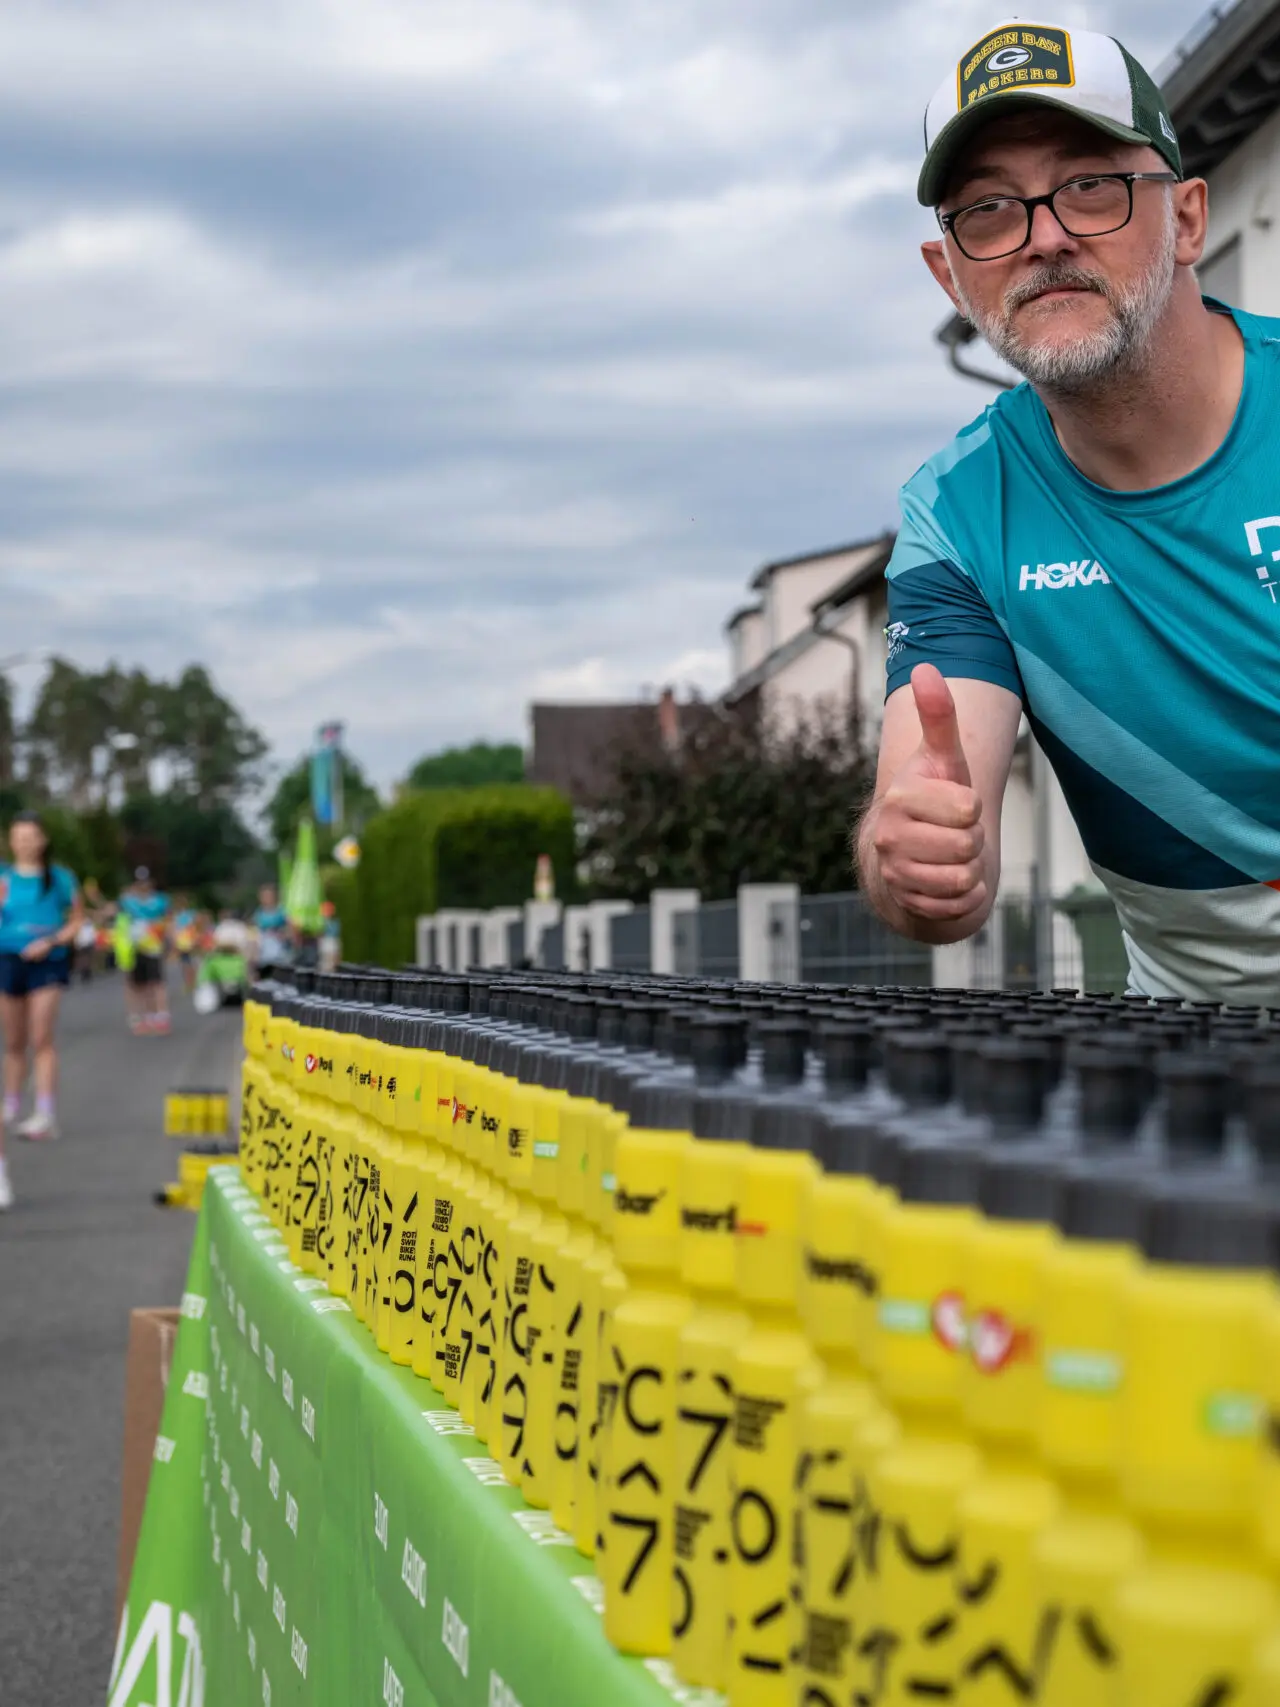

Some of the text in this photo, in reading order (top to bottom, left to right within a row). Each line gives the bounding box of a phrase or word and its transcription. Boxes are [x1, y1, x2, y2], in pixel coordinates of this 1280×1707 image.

[963, 31, 1061, 80] GREEN BAY
[967, 67, 1058, 104] PACKERS
[1018, 559, 1112, 591] HOKA
[401, 1230, 417, 1239] ROT
[400, 1238, 416, 1247] SWI
[399, 1246, 416, 1255] BIKE
[398, 1253, 416, 1262] RUN4
